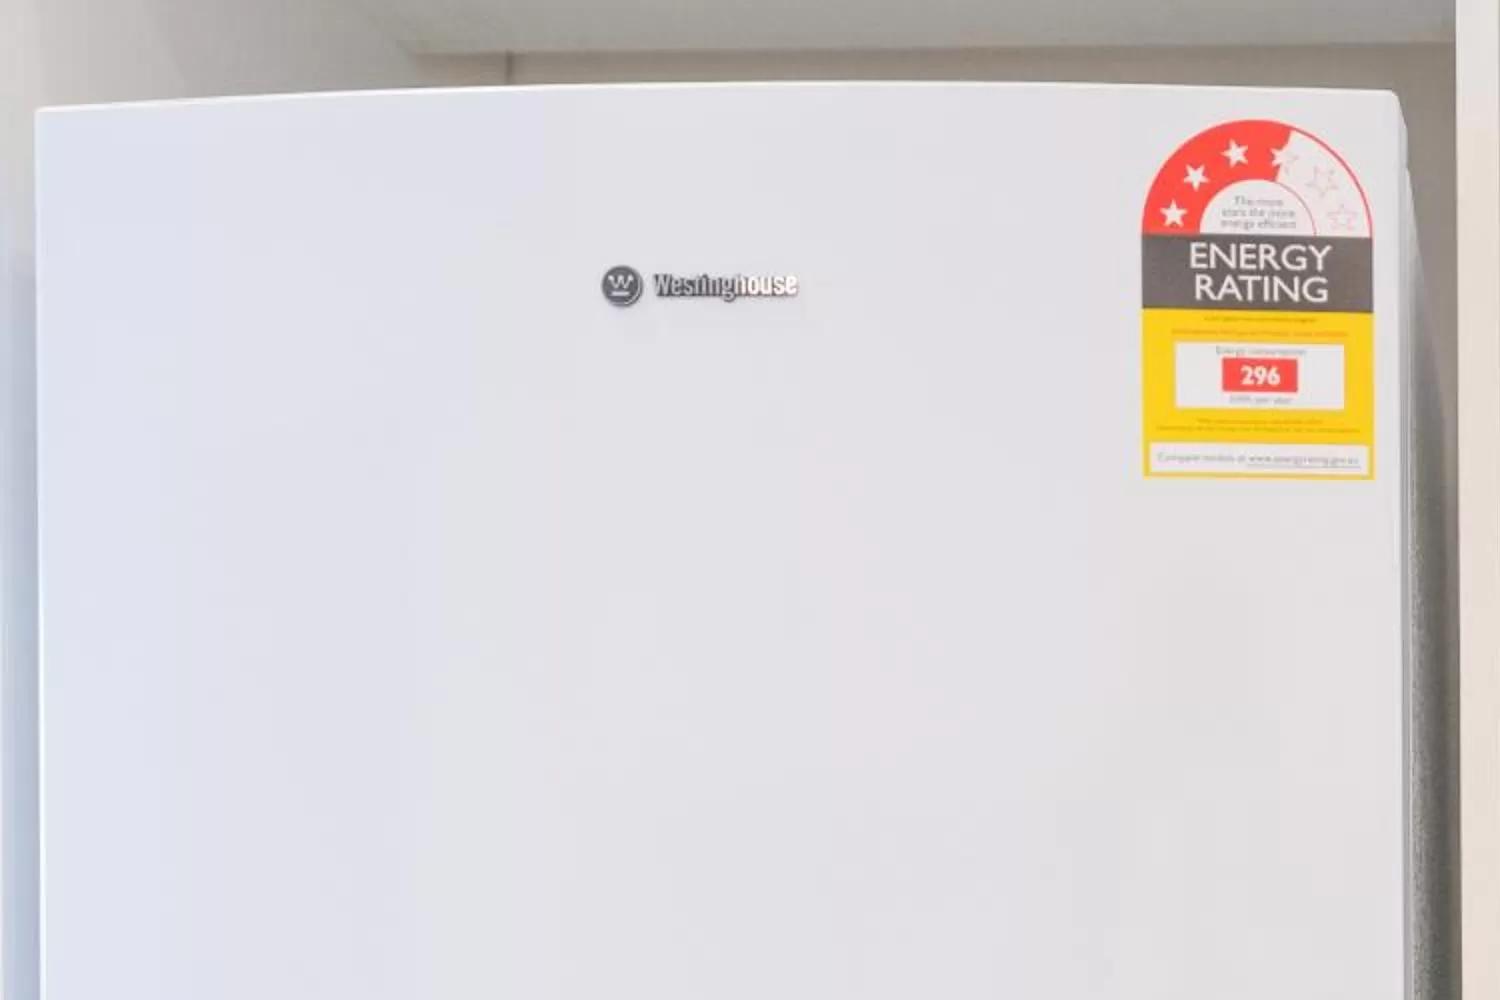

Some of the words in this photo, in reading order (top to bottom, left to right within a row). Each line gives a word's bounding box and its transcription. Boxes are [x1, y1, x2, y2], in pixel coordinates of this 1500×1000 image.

[1189, 242, 1333, 271] ENERGY
[653, 272, 799, 302] Westinghouse
[1194, 274, 1329, 303] RATING
[1239, 364, 1281, 386] 296
